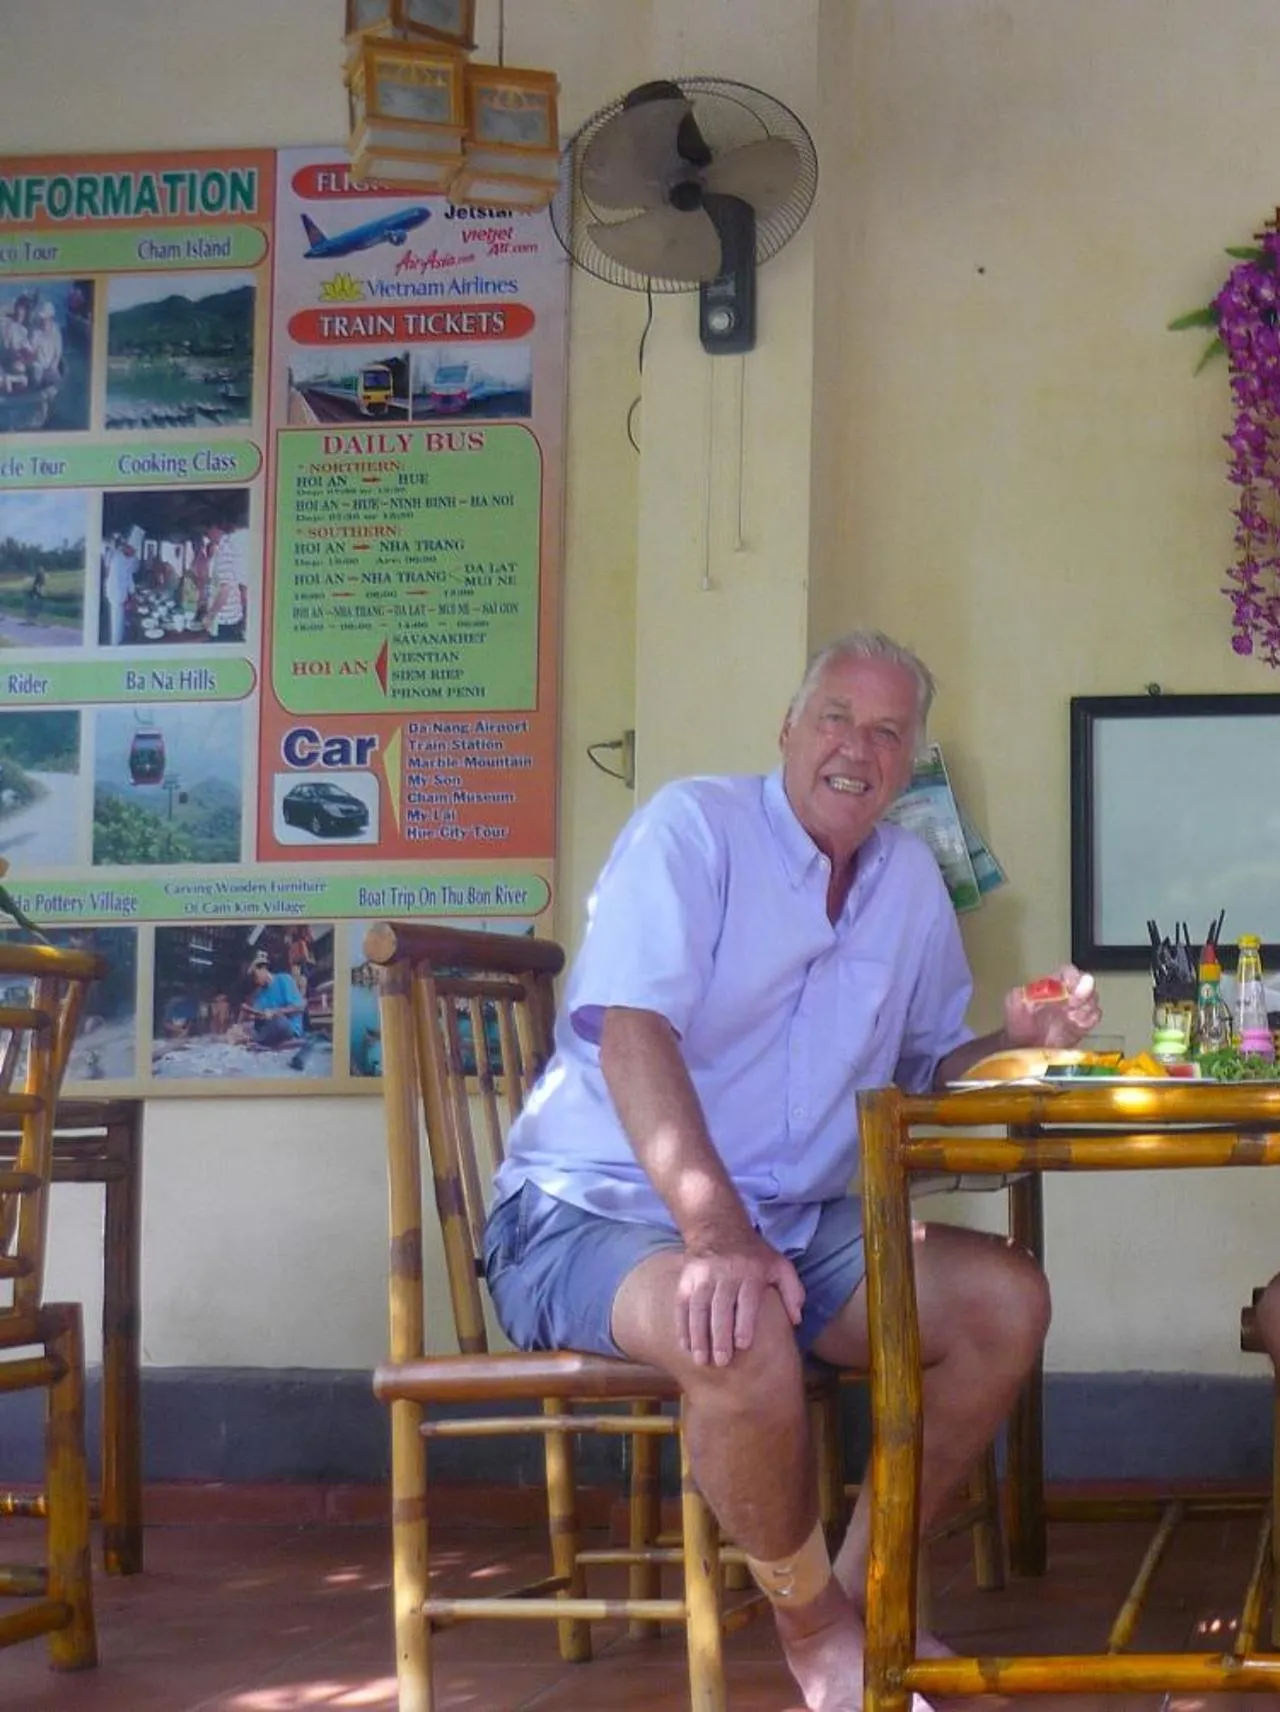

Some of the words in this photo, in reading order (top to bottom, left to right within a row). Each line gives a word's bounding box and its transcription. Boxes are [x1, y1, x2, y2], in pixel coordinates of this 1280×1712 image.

[0, 170, 256, 219] NFORMATION
[24, 242, 59, 261] Tour
[138, 240, 181, 260] Cham
[186, 237, 231, 257] Island
[367, 278, 445, 297] Vietnam
[448, 276, 519, 296] Airlines
[320, 315, 395, 337] TRAIN
[406, 311, 505, 335] TICKETS
[323, 433, 413, 455] DAILY
[426, 432, 484, 452] BUS
[31, 457, 66, 475] Tour
[118, 454, 187, 477] Cooking
[193, 452, 237, 471] Class
[327, 475, 347, 487] AN
[326, 541, 345, 552] AN
[380, 541, 409, 553] NHA
[416, 539, 465, 552] TRANG
[325, 572, 345, 585] AN
[361, 572, 392, 585] NHA
[398, 571, 446, 584] TRANG
[393, 652, 459, 664] VIENTIAN
[293, 661, 331, 676] HOI
[339, 660, 368, 675] AN
[8, 675, 48, 694] Rider
[126, 671, 145, 689] Ba
[153, 671, 174, 689] Na
[180, 669, 215, 690] Hills
[408, 722, 428, 733] Da
[432, 722, 469, 735] Nang
[475, 720, 528, 735] Airport
[284, 728, 377, 768] Car
[409, 739, 446, 750] Train
[452, 739, 504, 750] Station
[408, 757, 459, 768] Marble
[465, 756, 532, 768] Mountain
[434, 774, 460, 785] Son
[35, 893, 85, 916] Pottery
[90, 891, 138, 917] Village
[359, 887, 386, 907] Boat
[390, 887, 414, 910] Trip
[419, 888, 437, 906] On
[441, 886, 464, 905] Thu
[467, 887, 491, 905] Bon
[496, 885, 528, 905] River
